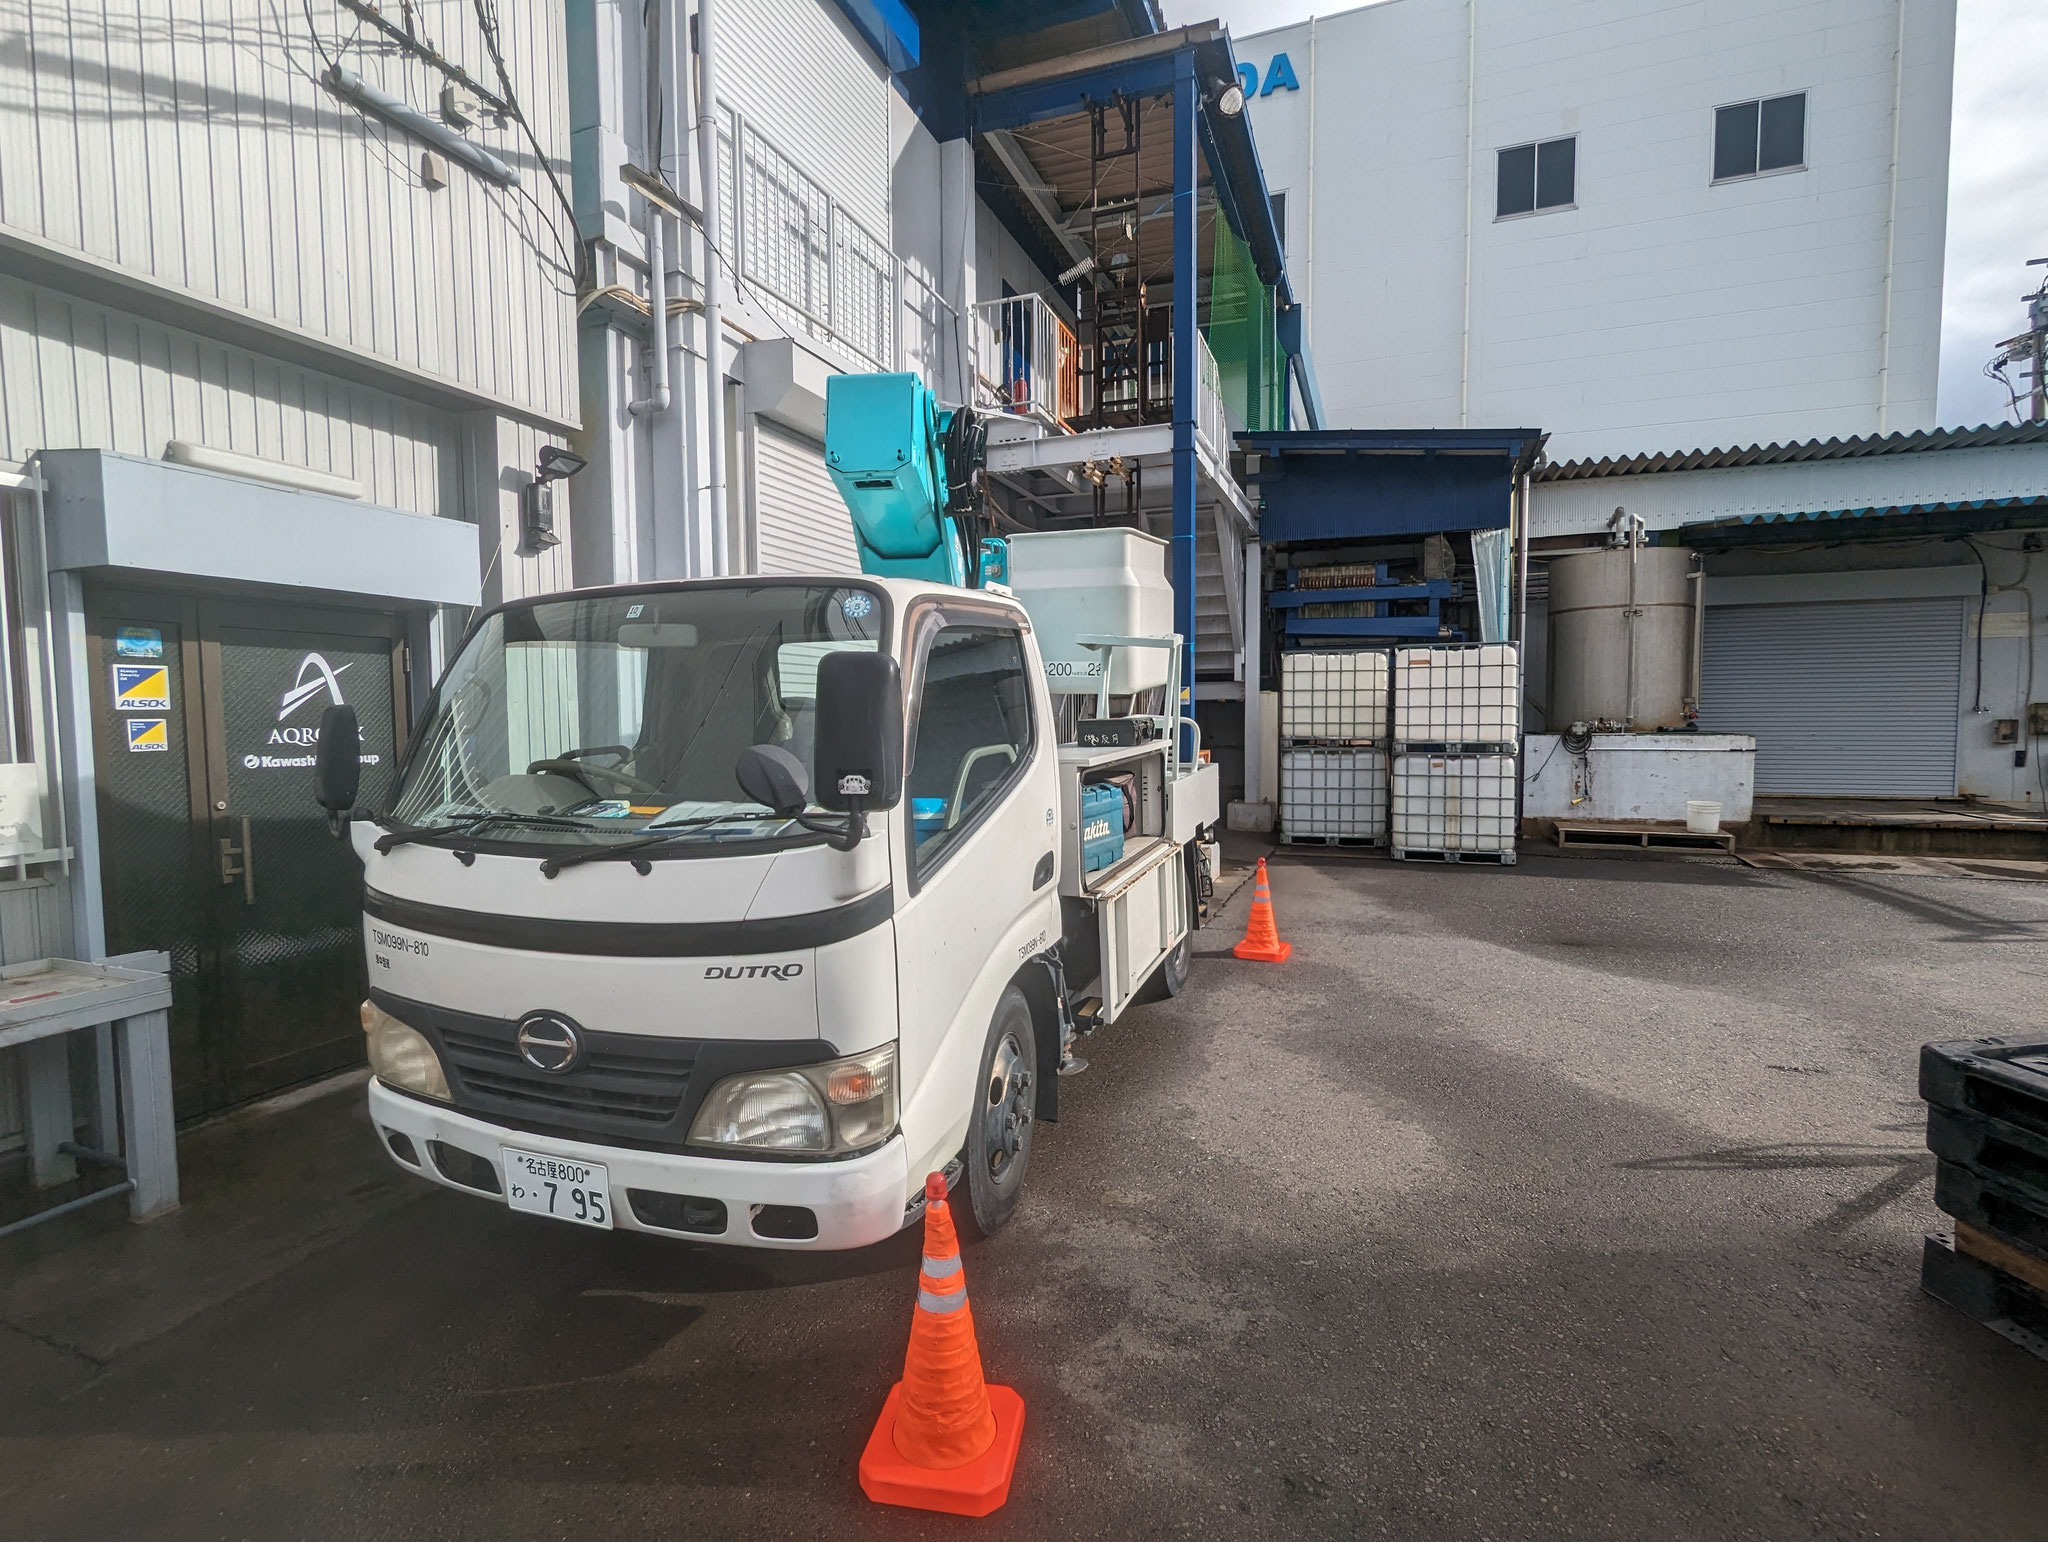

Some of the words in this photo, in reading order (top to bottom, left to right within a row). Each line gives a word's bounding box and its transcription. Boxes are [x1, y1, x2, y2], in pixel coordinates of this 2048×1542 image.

[1048, 663, 1072, 676] 200
[120, 699, 167, 708] ALSOK
[131, 743, 165, 751] ALSOK
[1083, 819, 1110, 841] akita
[372, 928, 430, 957] TSM099N-810
[703, 963, 804, 981] DUTRO
